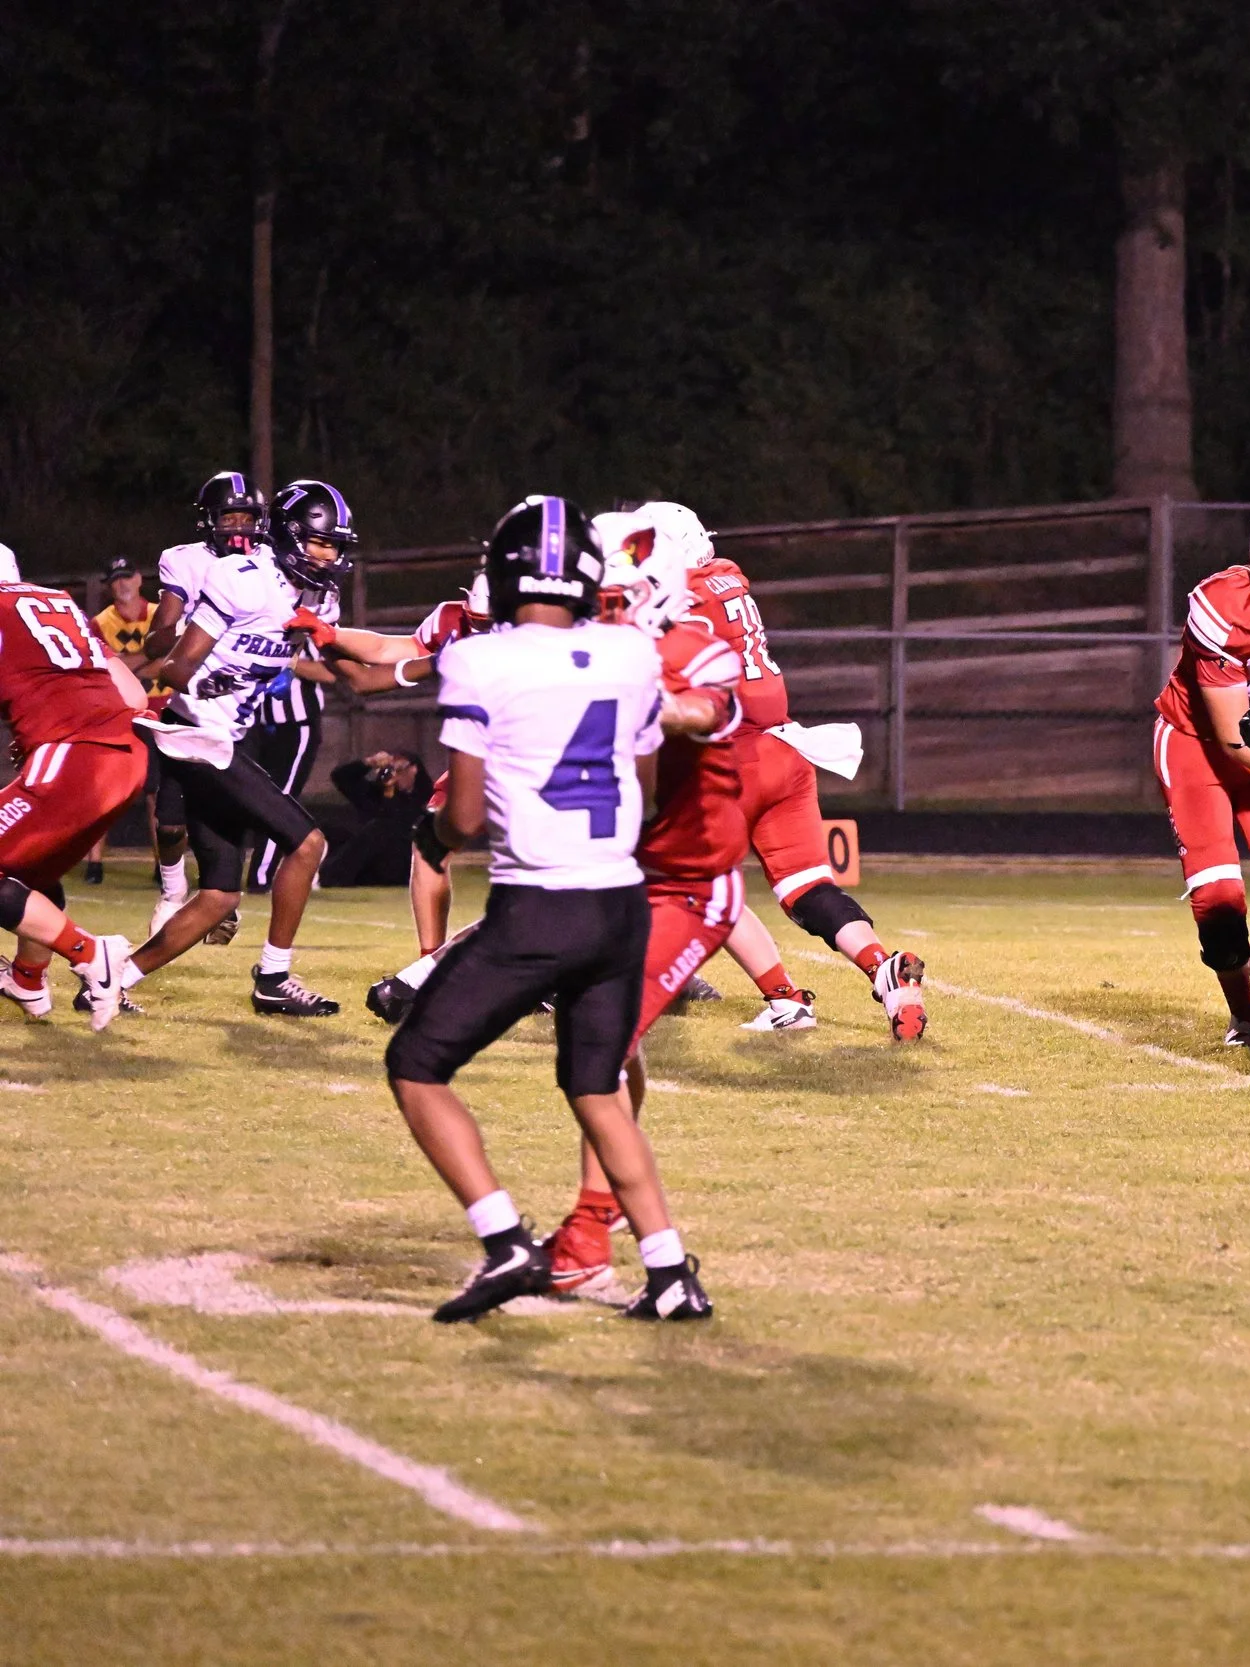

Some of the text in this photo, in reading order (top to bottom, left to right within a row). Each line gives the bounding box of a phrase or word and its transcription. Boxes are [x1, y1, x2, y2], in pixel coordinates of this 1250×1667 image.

[282, 488, 308, 510] 7
[237, 559, 259, 573] 7
[15, 596, 109, 670] 67
[231, 633, 296, 658] PHARA
[538, 698, 621, 840] 4
[658, 938, 707, 993] CARDS
